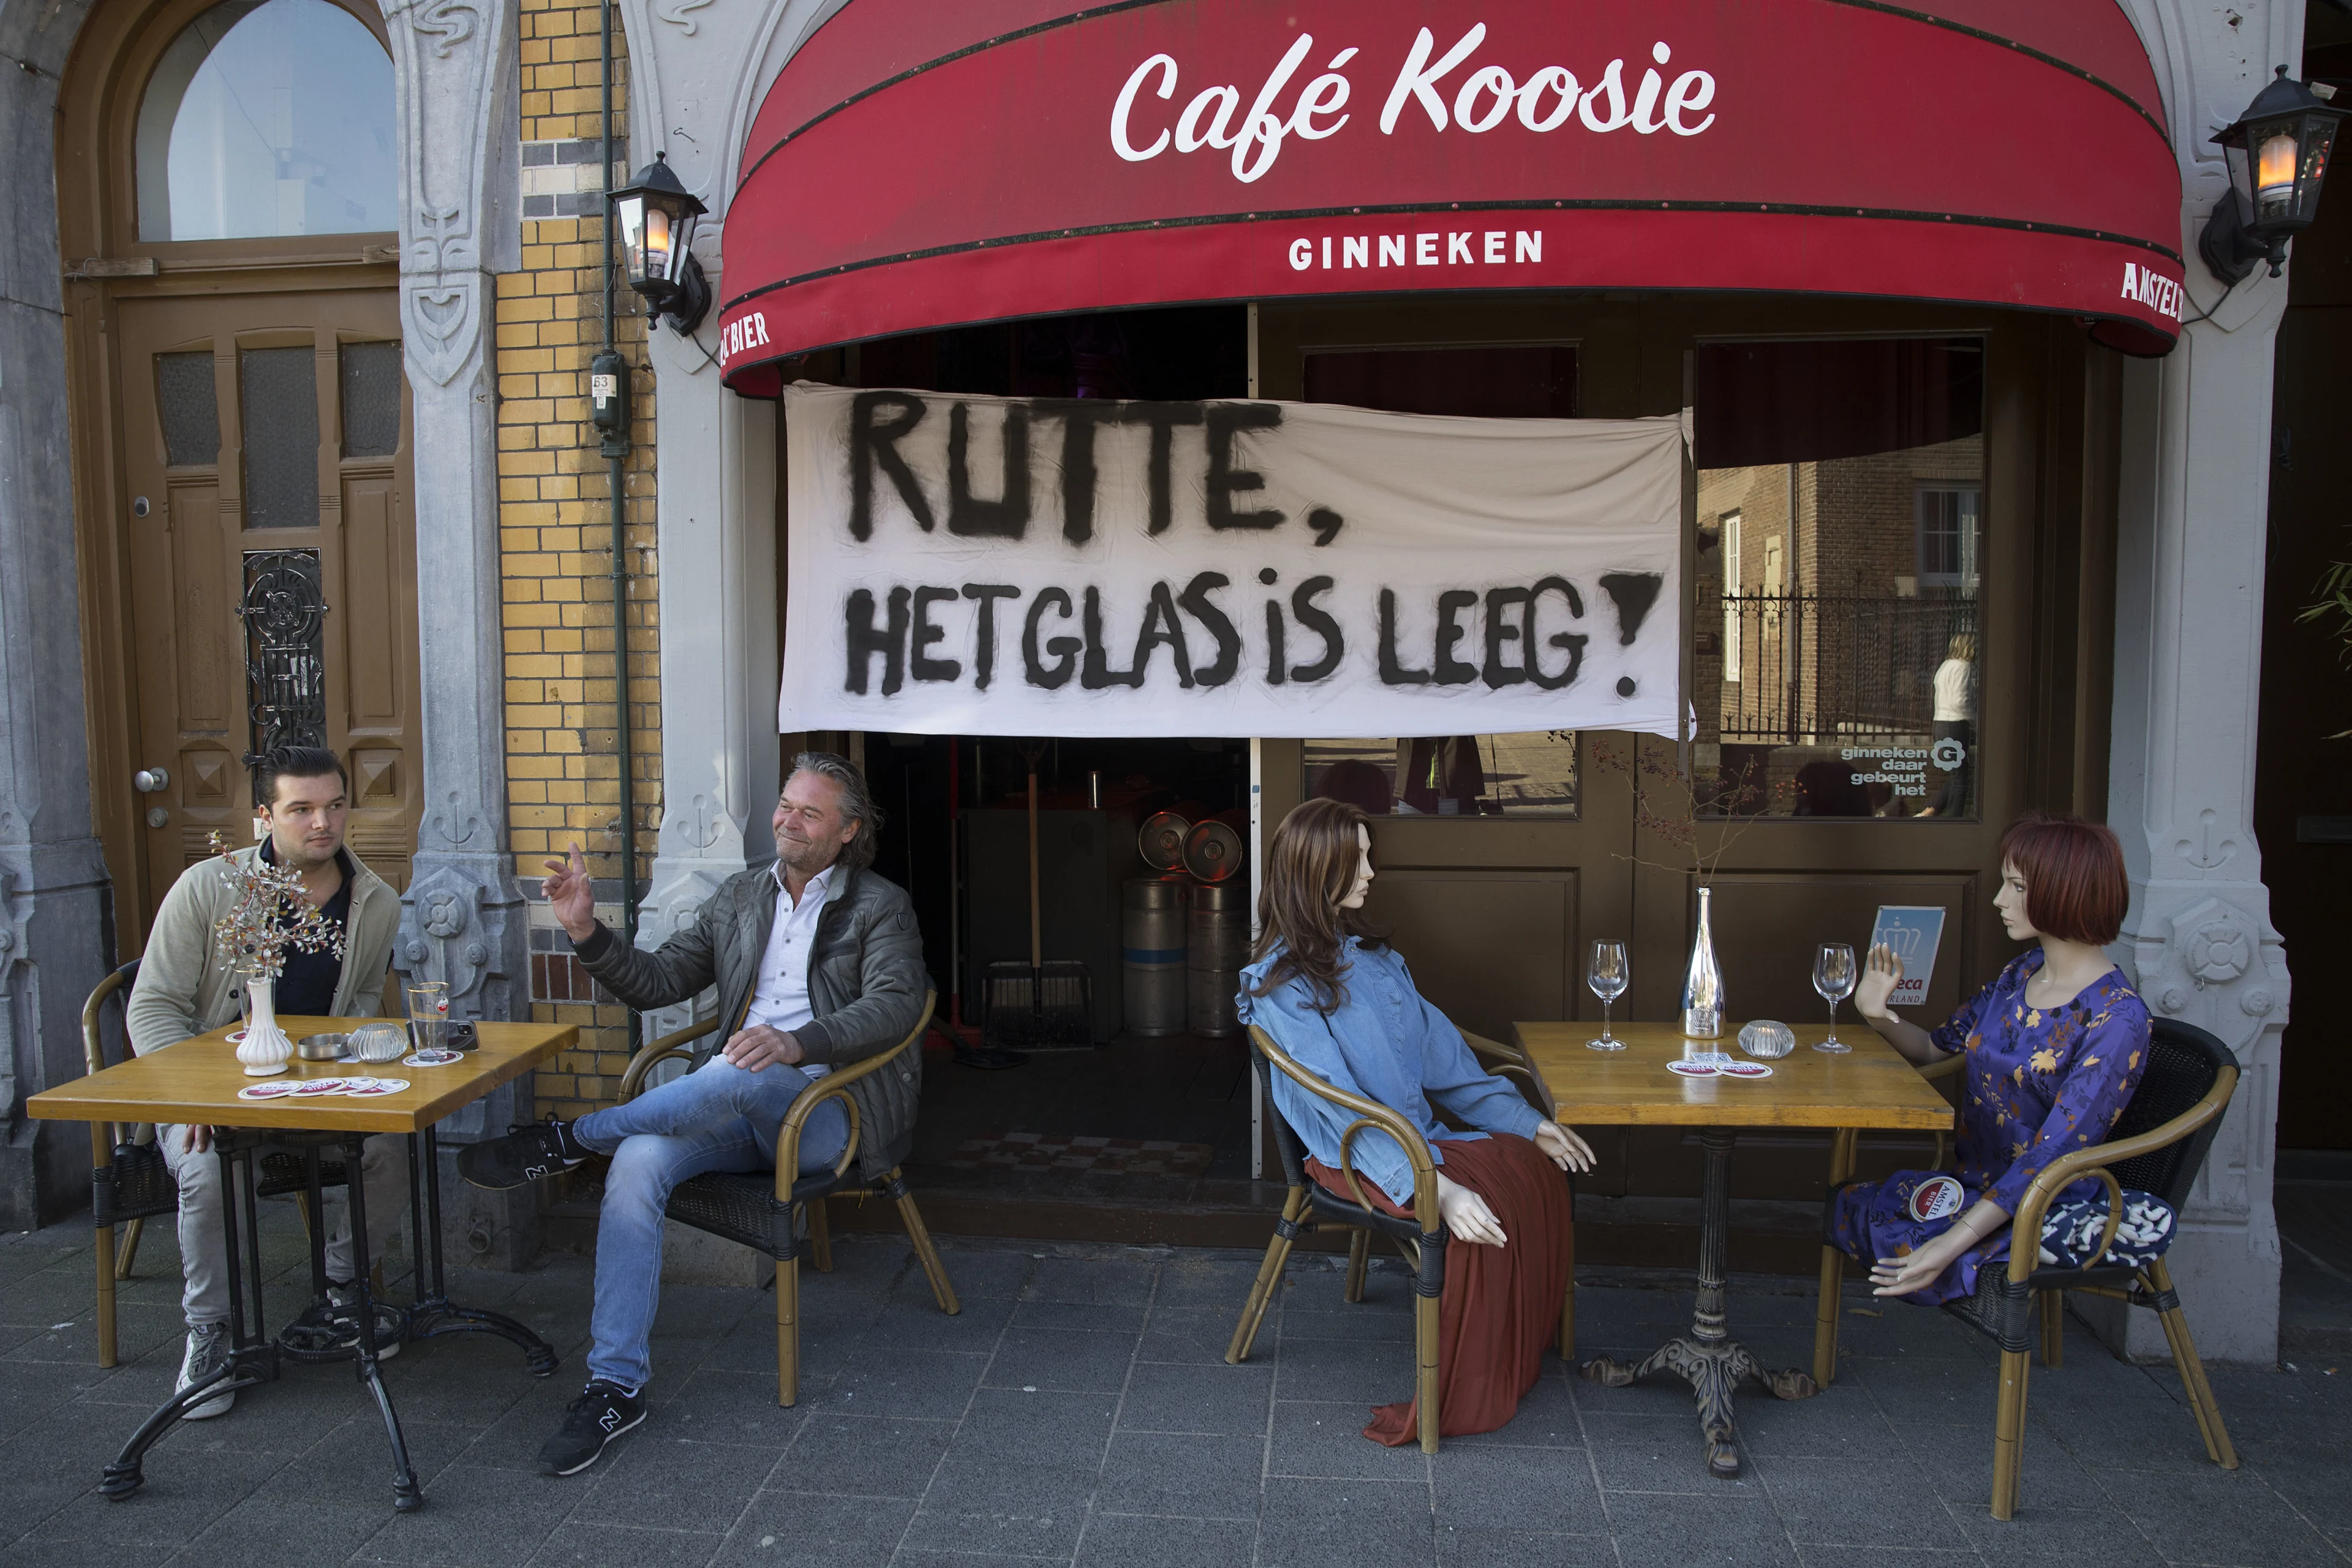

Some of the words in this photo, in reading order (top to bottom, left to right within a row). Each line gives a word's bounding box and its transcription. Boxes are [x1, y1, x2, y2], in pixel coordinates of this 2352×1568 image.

[1110, 32, 1359, 184] Café
[1379, 22, 1716, 136] Koosie
[1289, 230, 1543, 271] GINNEKEN
[2120, 262, 2179, 318] AMSTEL
[731, 312, 770, 355] BIER
[594, 376, 608, 388] 63
[849, 390, 1343, 547] RUTTE,
[1378, 572, 1664, 697] LEEG!
[1841, 747, 1928, 760] ginneken
[1937, 746, 1958, 763] G
[1882, 759, 1928, 771] daar
[1850, 771, 1926, 785] gebeurt
[1894, 784, 1926, 796] het
[1896, 979, 1923, 990] eca
[1890, 995, 1920, 1003] RLAND
[1924, 1191, 1937, 1206] BIER
[1928, 1185, 1950, 1216] AMSTEL
